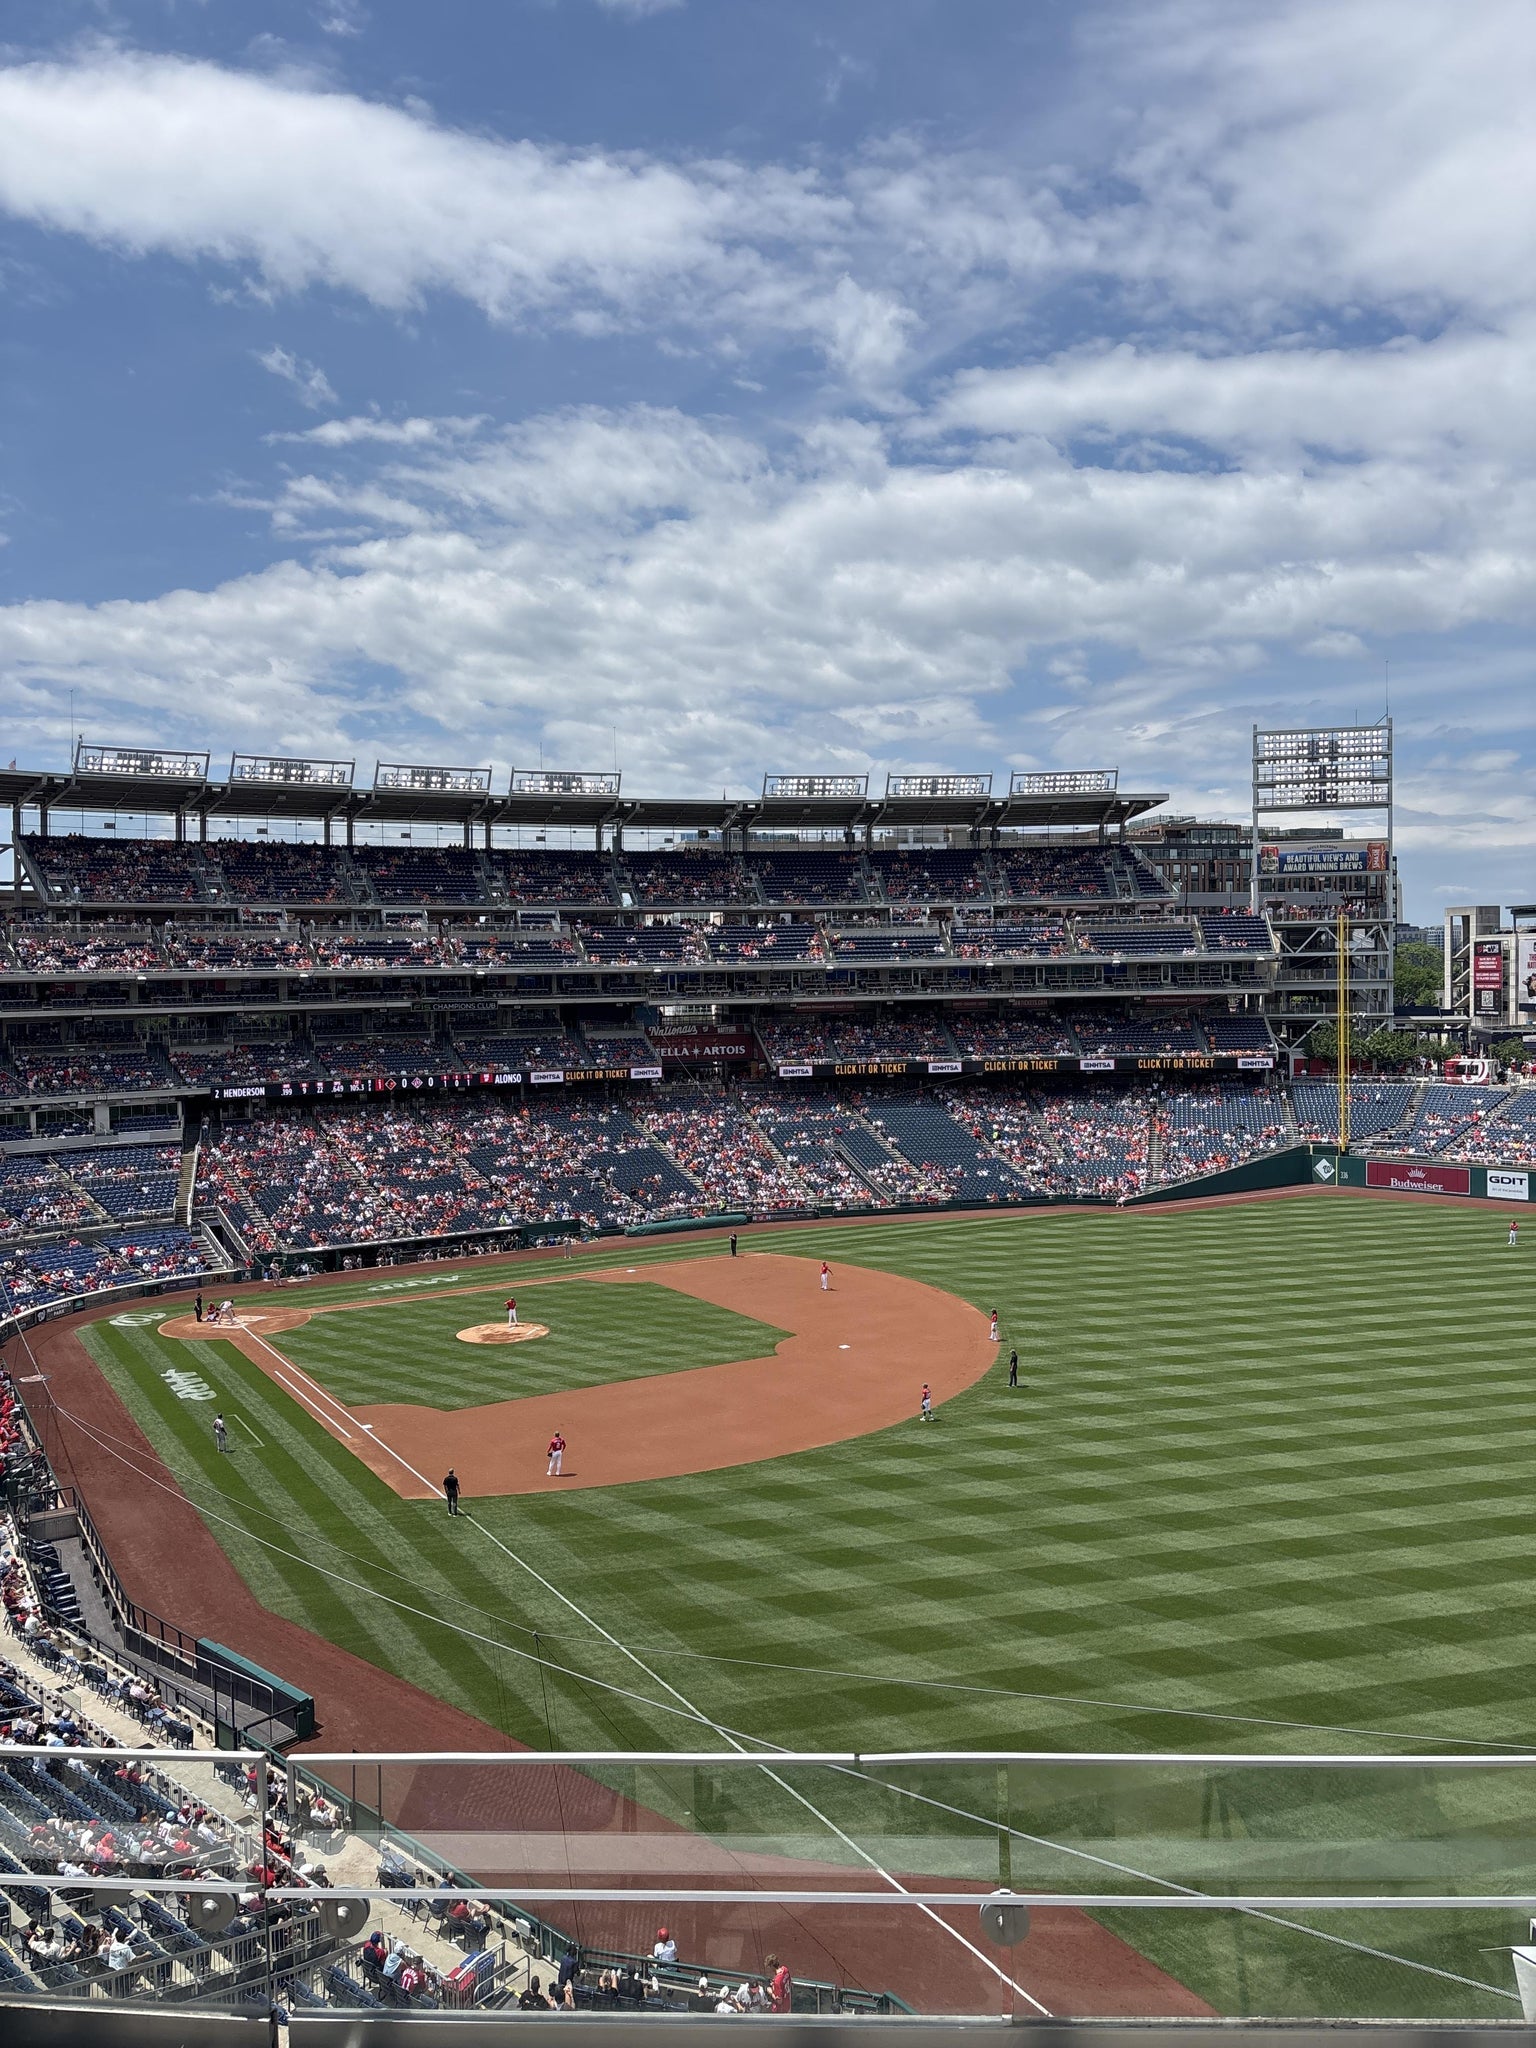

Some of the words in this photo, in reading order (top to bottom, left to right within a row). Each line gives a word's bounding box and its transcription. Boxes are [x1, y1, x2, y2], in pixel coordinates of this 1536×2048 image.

[1286, 854, 1321, 864] BEAUTIFUL
[1323, 854, 1344, 862] VIEWS
[1345, 853, 1360, 862] AND
[1283, 863, 1306, 872] AWARD
[1308, 862, 1338, 871] WINNING
[1340, 862, 1363, 870] BREWS
[648, 1024, 698, 1036] Nationals
[703, 1046, 746, 1056] ARTOIS
[835, 1065, 857, 1075] CLICK
[858, 1064, 866, 1074] IT
[868, 1064, 878, 1074] OR
[880, 1063, 907, 1073] TICKET
[984, 1061, 1006, 1071] CLICK
[1008, 1061, 1016, 1071] IT
[1018, 1061, 1028, 1070] OR
[1031, 1060, 1058, 1070] TICKET
[1138, 1059, 1160, 1069] CLICK
[1163, 1059, 1170, 1068] IT
[1173, 1058, 1184, 1068] OR
[1186, 1058, 1215, 1068] TICKET
[494, 1074, 522, 1084] ALONSO
[566, 1071, 585, 1080] CLICK
[586, 1070, 594, 1079] IT
[595, 1070, 603, 1079] OR
[605, 1069, 628, 1078] TICKET
[401, 1078, 407, 1088] 0
[428, 1077, 434, 1087] 0
[215, 1089, 219, 1098] 2
[223, 1087, 265, 1098] HENDERSON
[350, 1084, 364, 1092] 105.3
[1489, 1176, 1526, 1186] GDIT
[47, 1302, 72, 1313] NATIONALS
[160, 1369, 217, 1400] AARP
[158, 1826, 168, 1838] 20
[402, 1976, 412, 1990] 11
